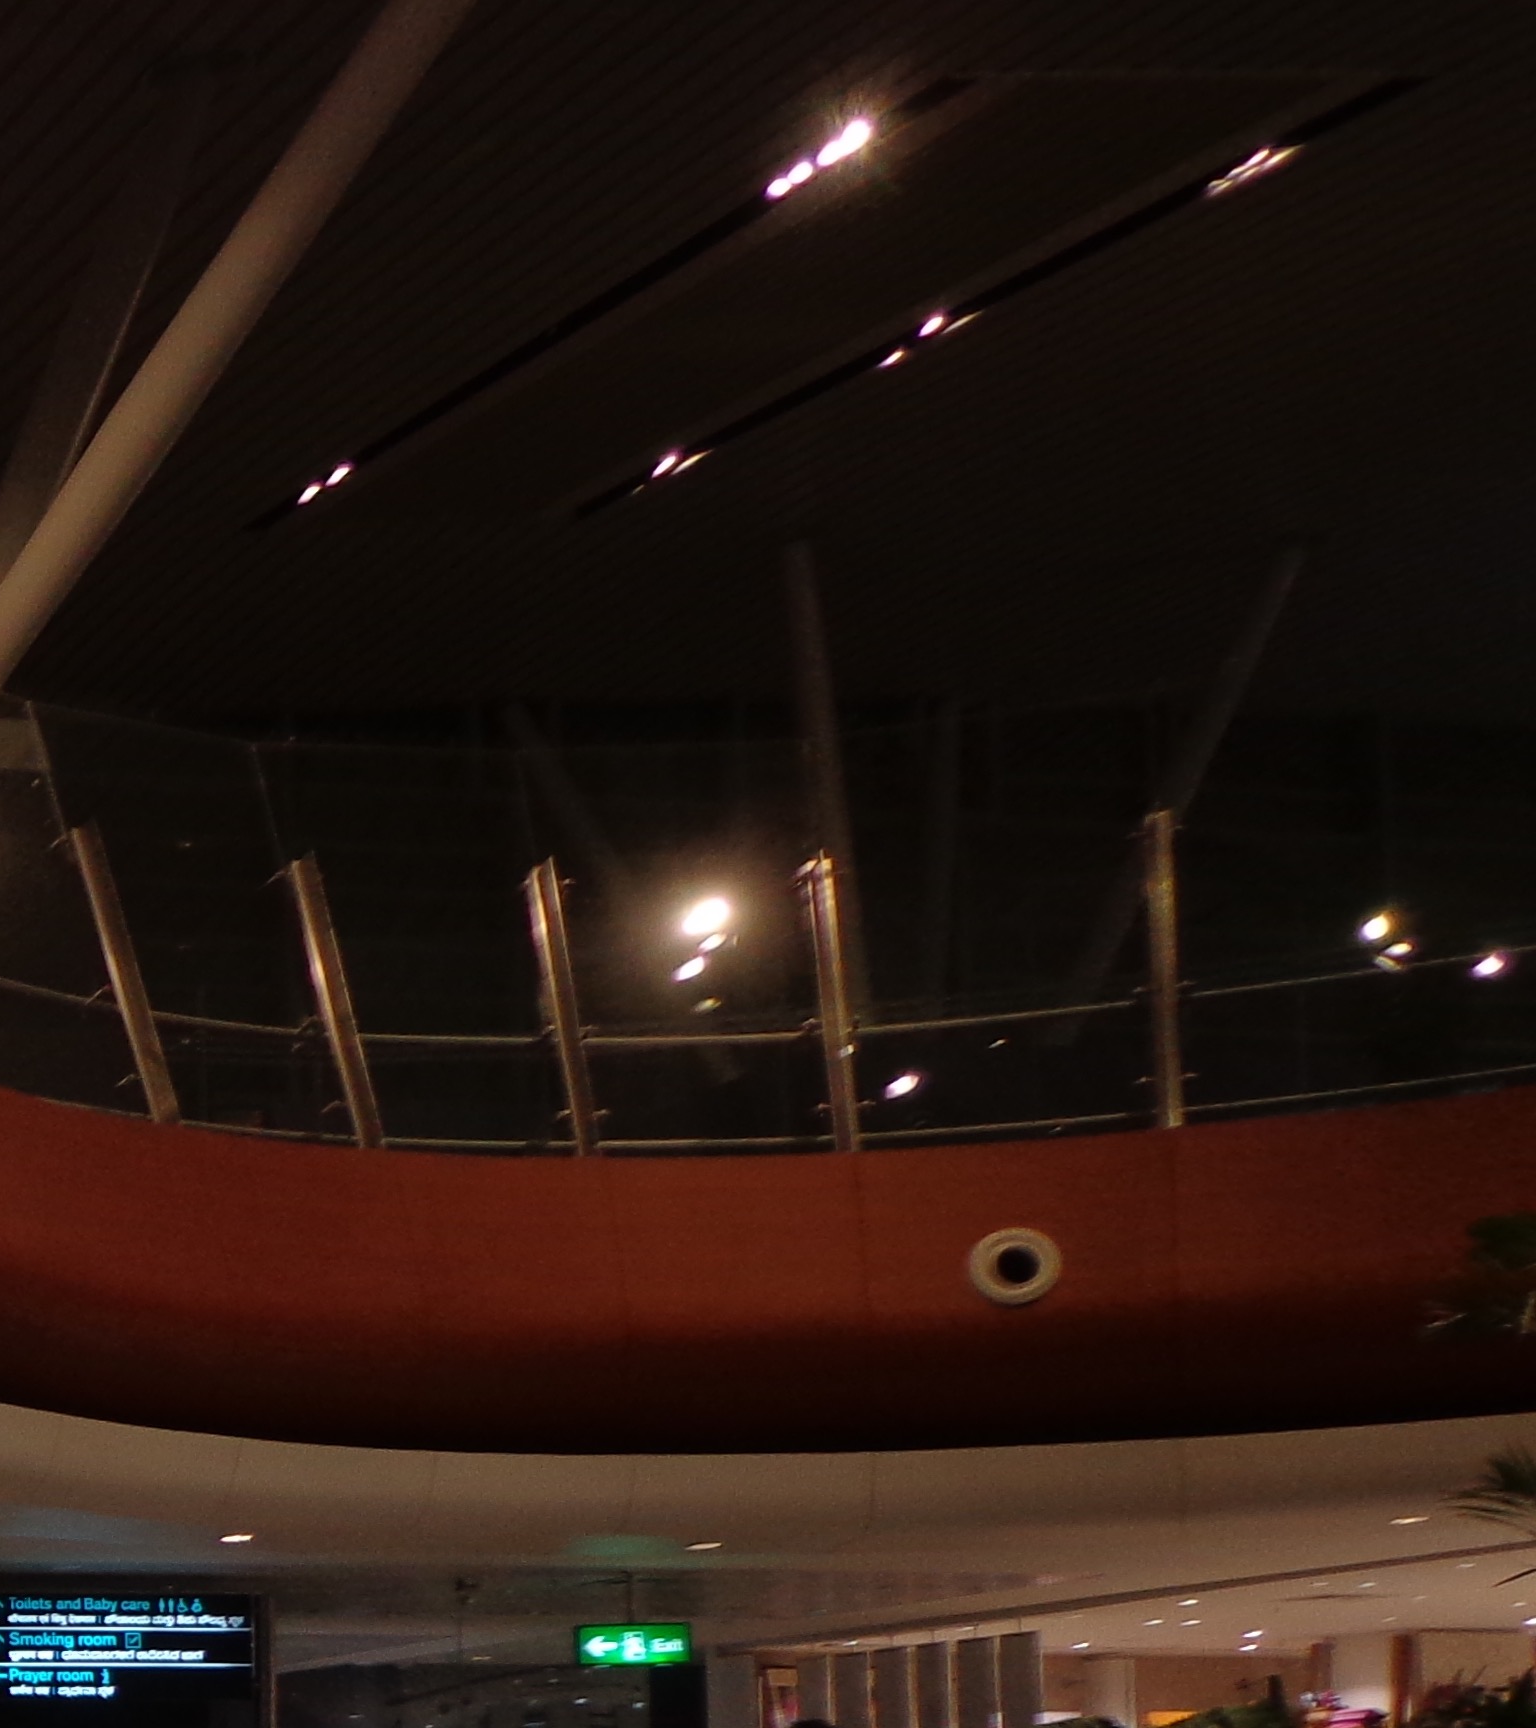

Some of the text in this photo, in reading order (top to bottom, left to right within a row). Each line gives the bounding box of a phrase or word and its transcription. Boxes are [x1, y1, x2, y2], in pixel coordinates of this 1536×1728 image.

[8, 1597, 150, 1612] Toilets and Baby care
[8, 1632, 117, 1648] Smoking room
[8, 1668, 94, 1684] Prayer room
